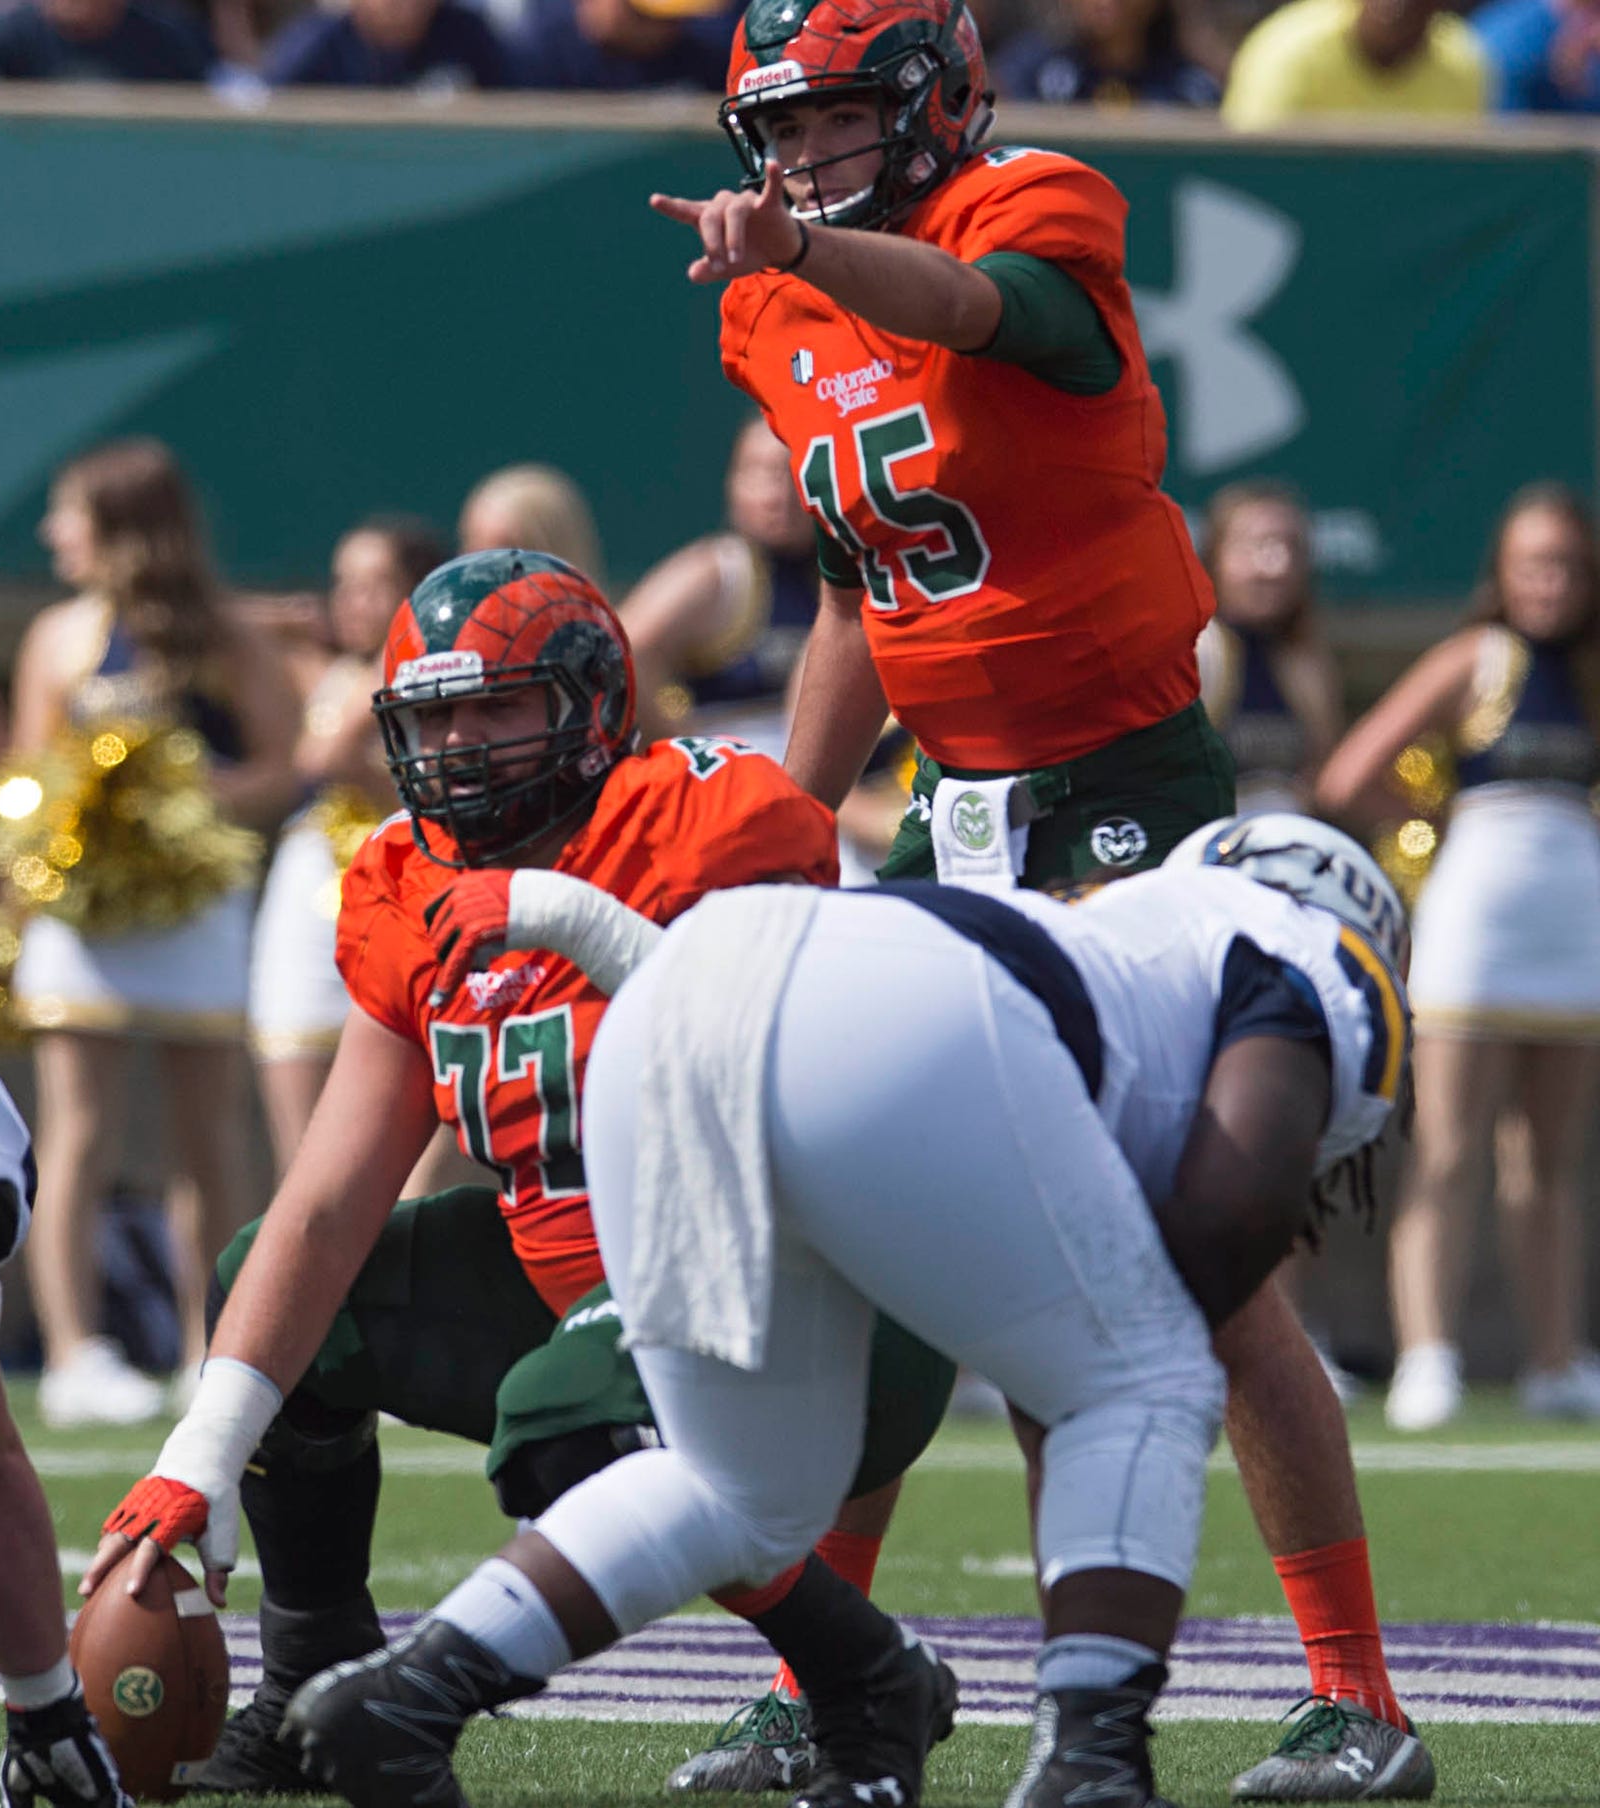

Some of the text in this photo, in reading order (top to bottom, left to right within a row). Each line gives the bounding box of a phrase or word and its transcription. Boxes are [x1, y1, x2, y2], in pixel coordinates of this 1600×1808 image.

[744, 67, 795, 89] Riddell
[816, 357, 895, 401] Colorado
[835, 386, 879, 418] State
[798, 402, 992, 611] 15
[429, 1002, 590, 1208] 77
